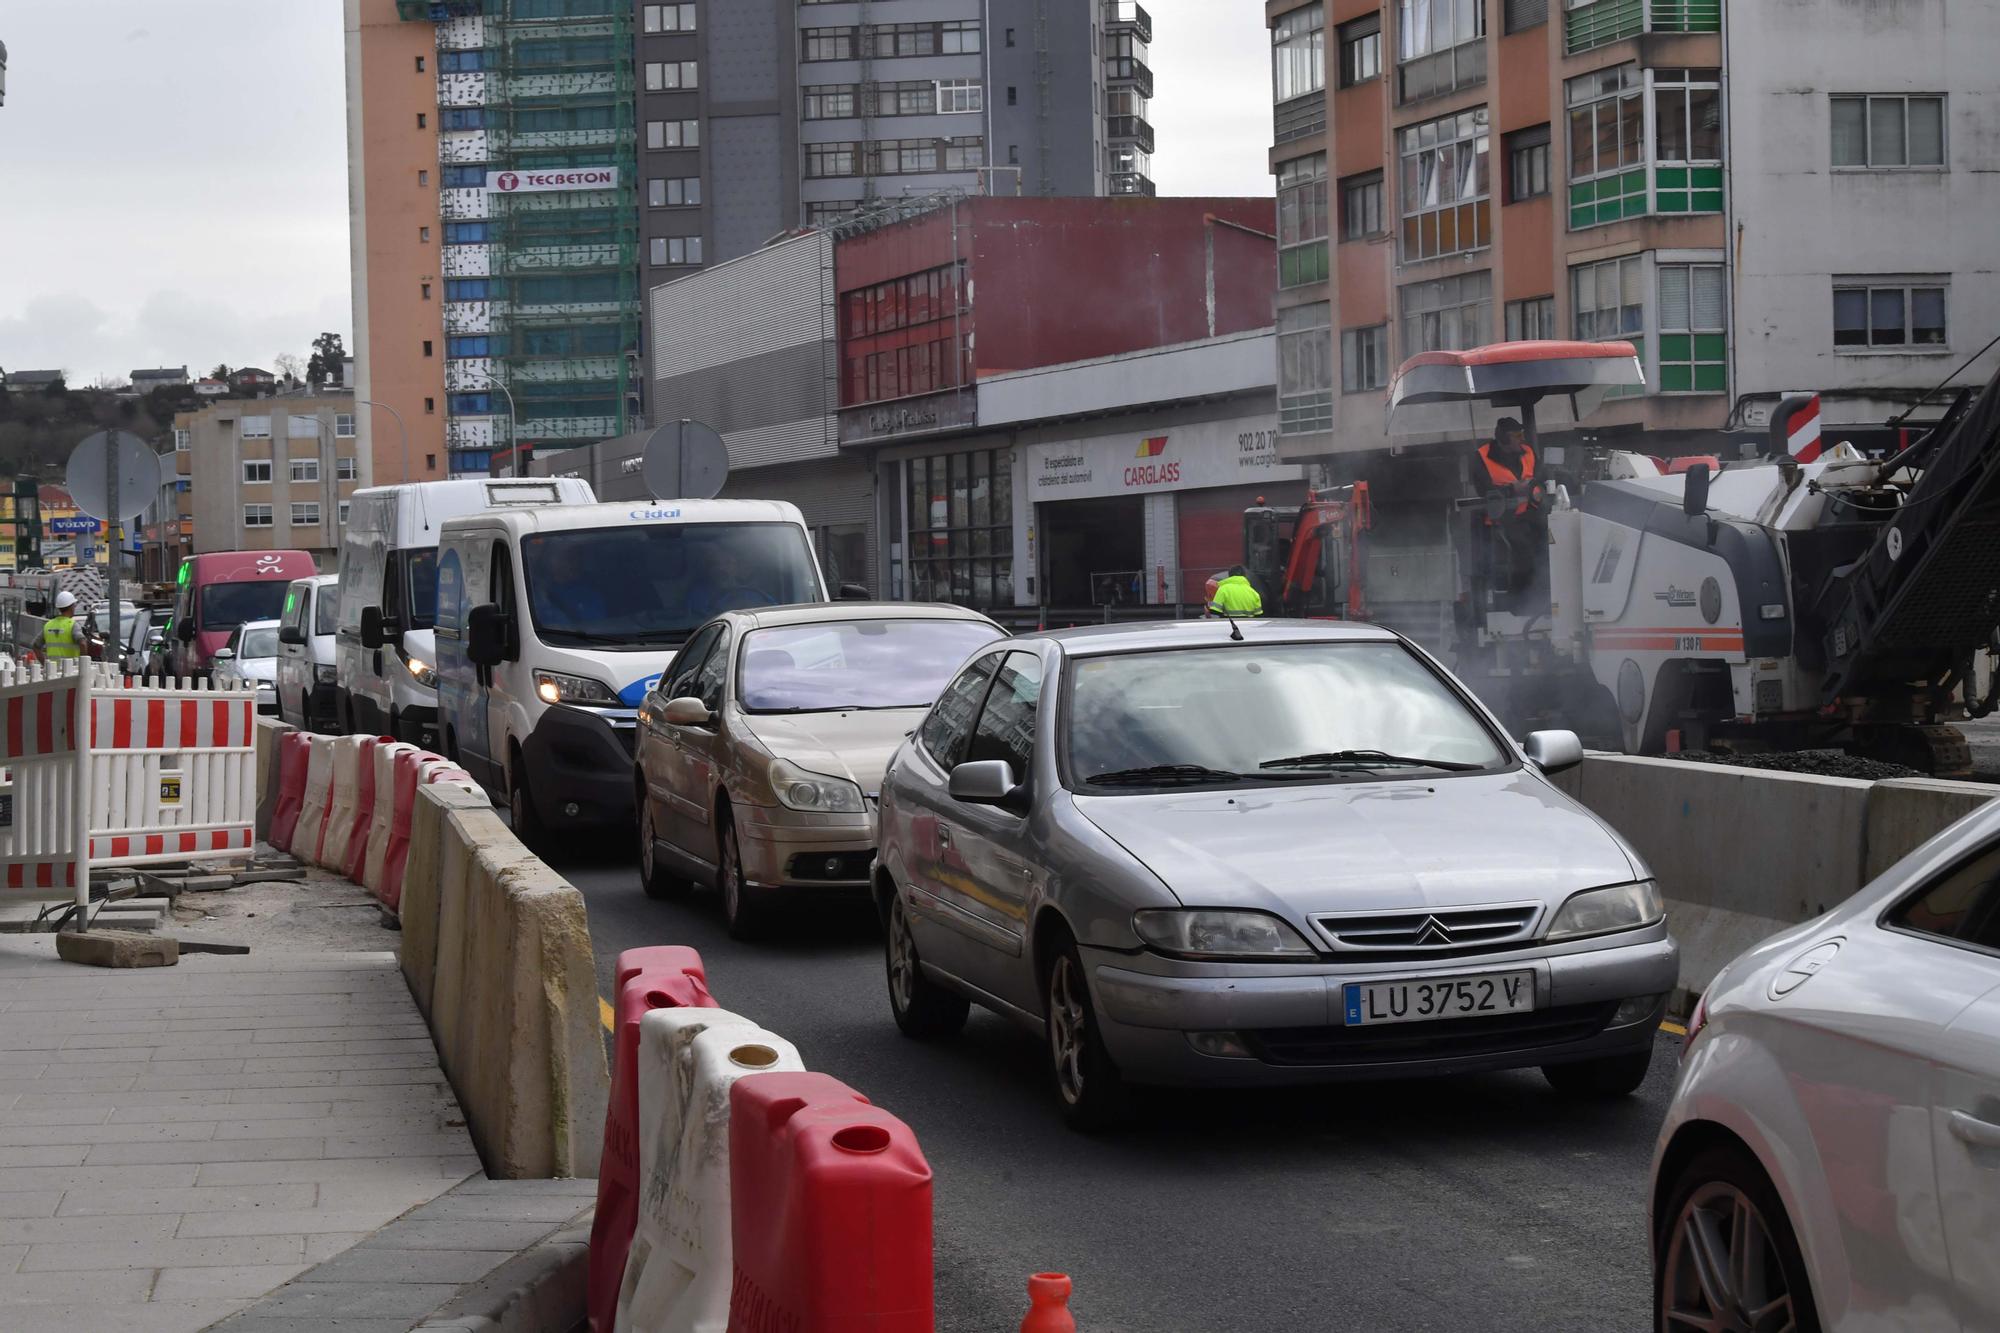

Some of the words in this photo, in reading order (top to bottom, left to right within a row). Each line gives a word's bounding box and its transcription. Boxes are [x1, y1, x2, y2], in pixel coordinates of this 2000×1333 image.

[527, 171, 611, 185] TECBETON
[1239, 433, 1253, 451] 902
[1256, 431, 1265, 450] 20
[1124, 462, 1180, 486] CARGLASS
[56, 521, 95, 529] VOLVO
[1682, 636, 1695, 651] 130
[1368, 985, 1409, 1019] LU
[1416, 979, 1497, 1015] 3752
[1502, 976, 1521, 1008] V
[1349, 1008, 1357, 1018] E
